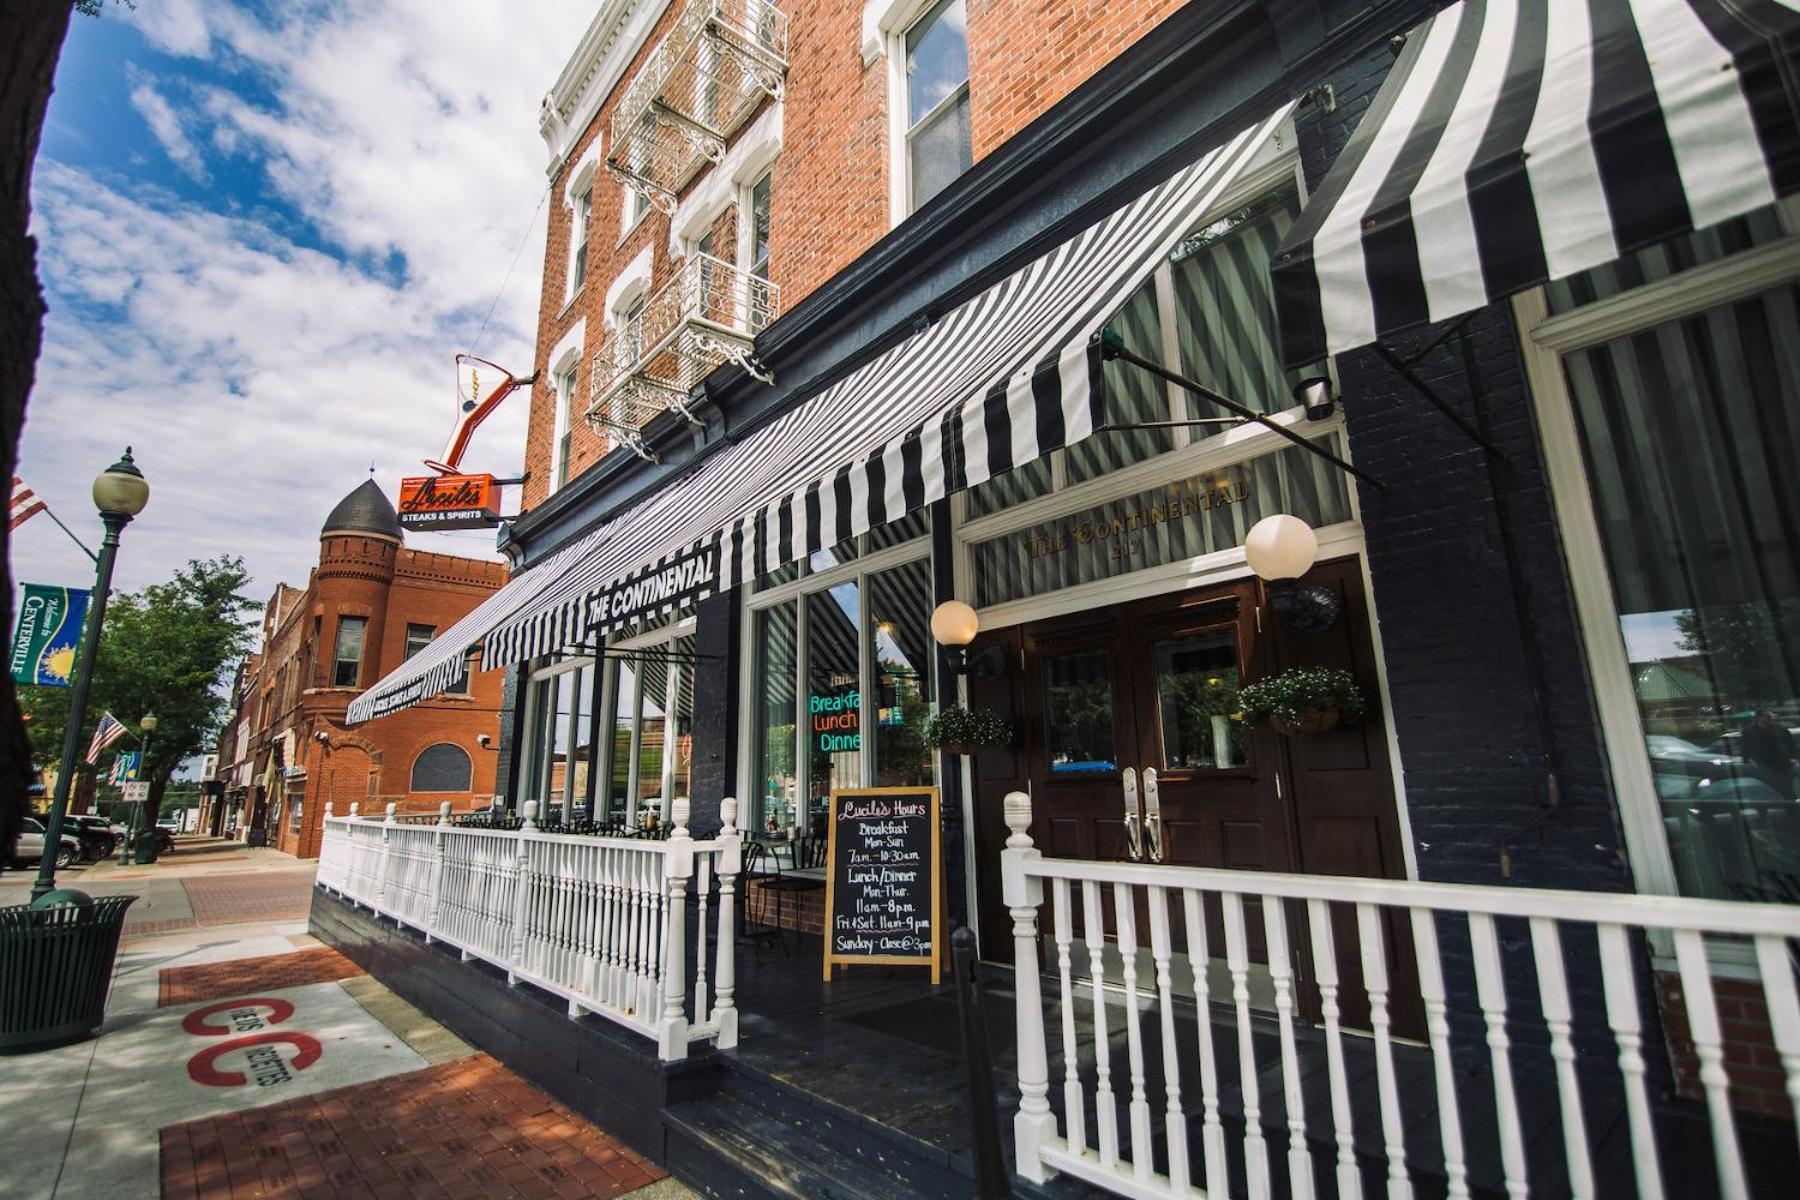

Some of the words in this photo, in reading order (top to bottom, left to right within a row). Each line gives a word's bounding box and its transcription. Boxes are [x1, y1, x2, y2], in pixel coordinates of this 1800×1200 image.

[401, 477, 481, 510] Lucile's
[402, 512, 437, 522] STEAKS
[438, 512, 445, 520] &
[446, 510, 481, 520] SPIRITS
[588, 598, 610, 626] THE
[611, 550, 715, 617] CONTINENTAL
[42, 597, 59, 628] Welcome
[10, 595, 45, 673] CENTERVILLE
[810, 690, 861, 713] Breakfa
[814, 711, 858, 732] Lunch
[821, 733, 862, 751] Dinne
[838, 800, 891, 820] Lucile's
[894, 800, 926, 817] Hours
[858, 820, 909, 836] Breakfast
[864, 836, 904, 848] Mon-Sun
